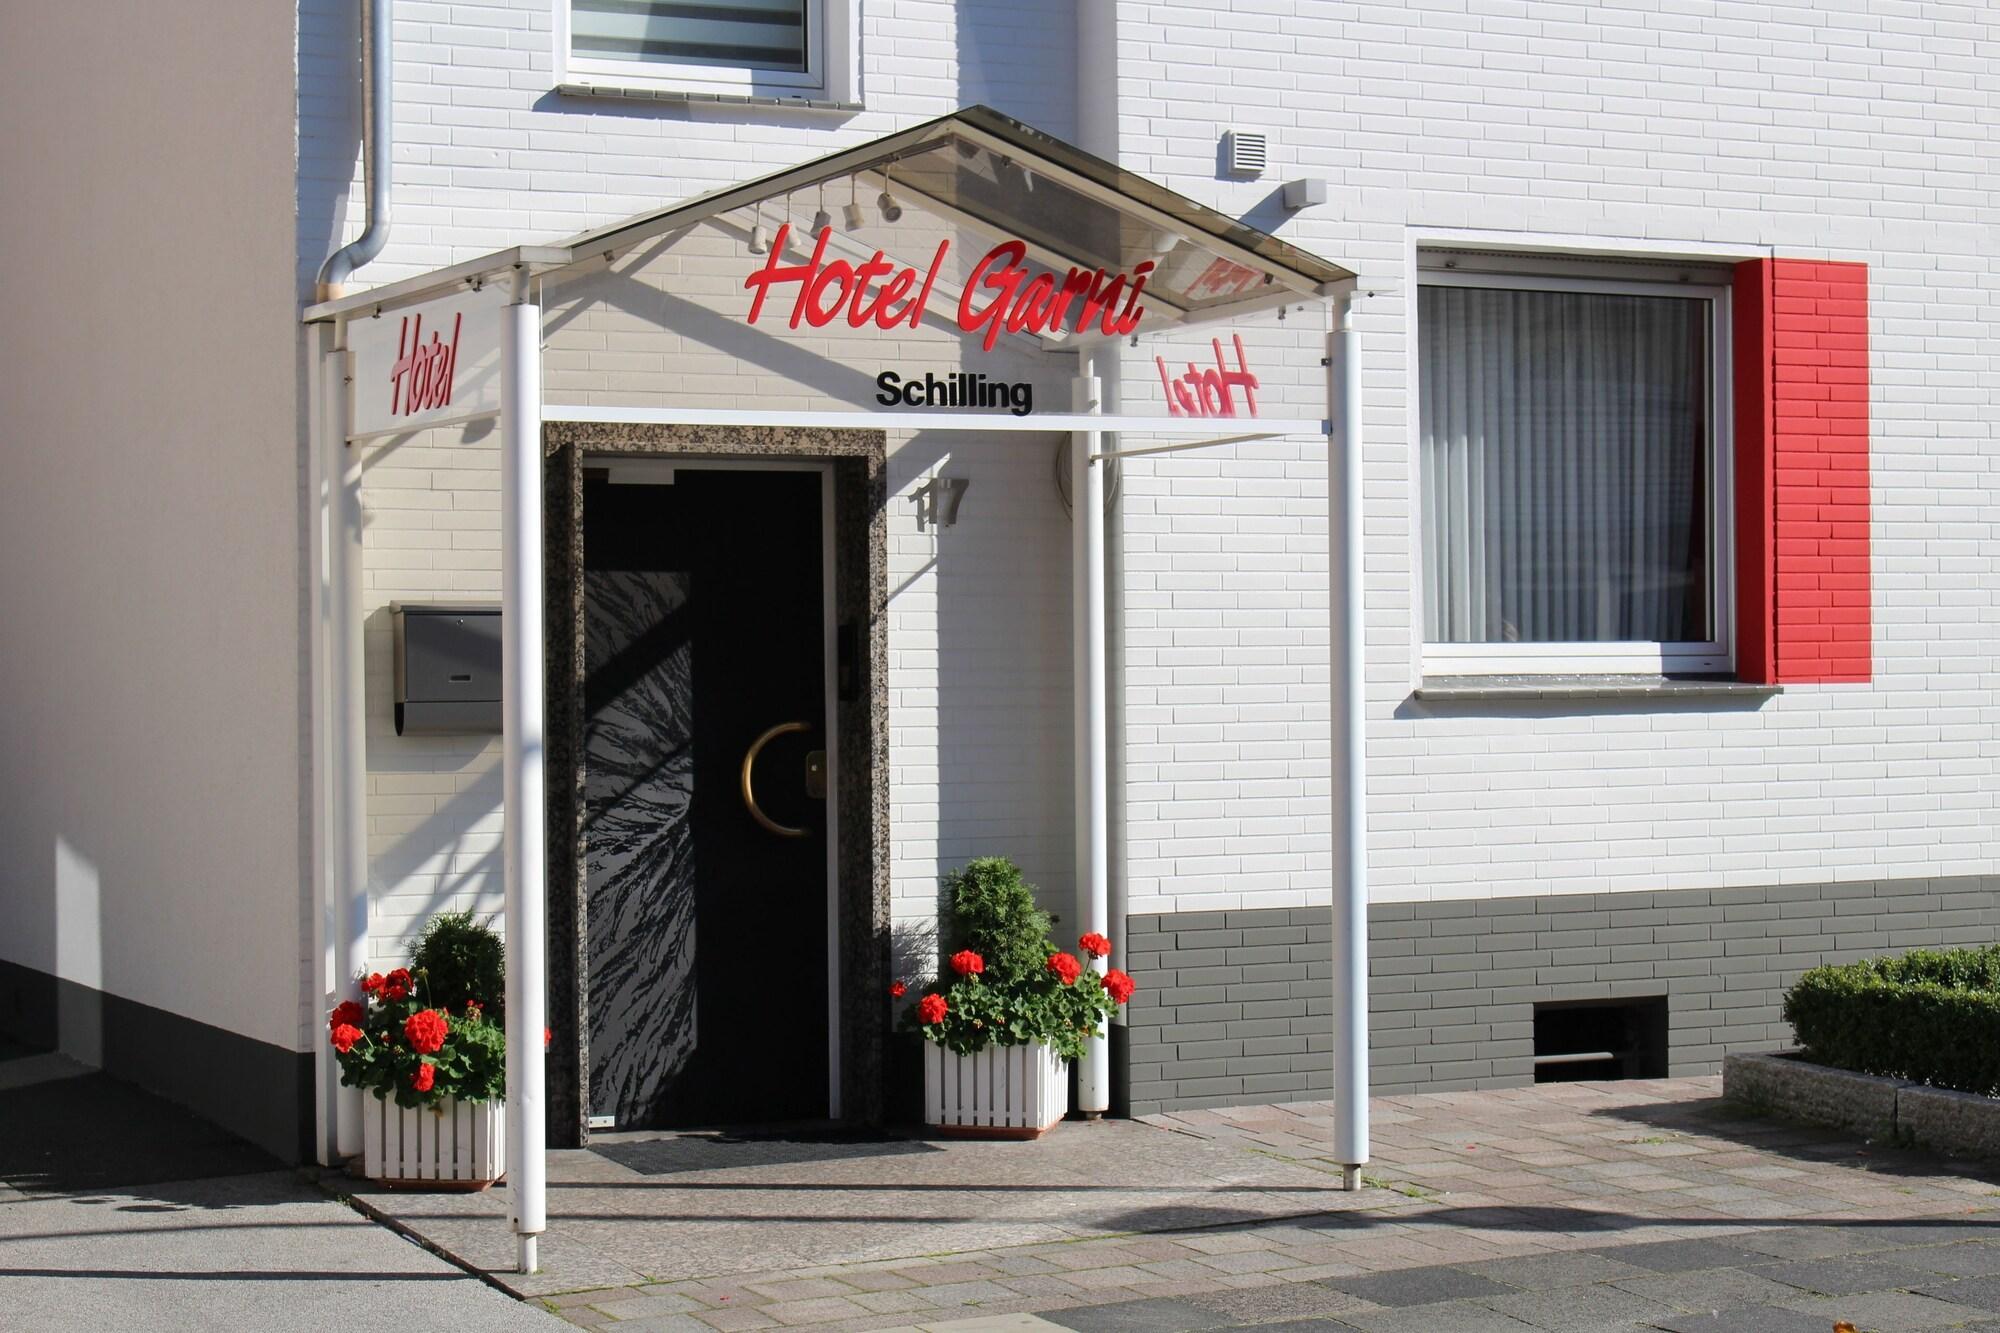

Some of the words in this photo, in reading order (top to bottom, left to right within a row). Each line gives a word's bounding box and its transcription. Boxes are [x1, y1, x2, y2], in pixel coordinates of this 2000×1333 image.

[745, 224, 950, 330] Hotel
[957, 239, 1155, 352] Garni
[391, 312, 462, 416] Hotel
[876, 372, 1033, 417] Schilling
